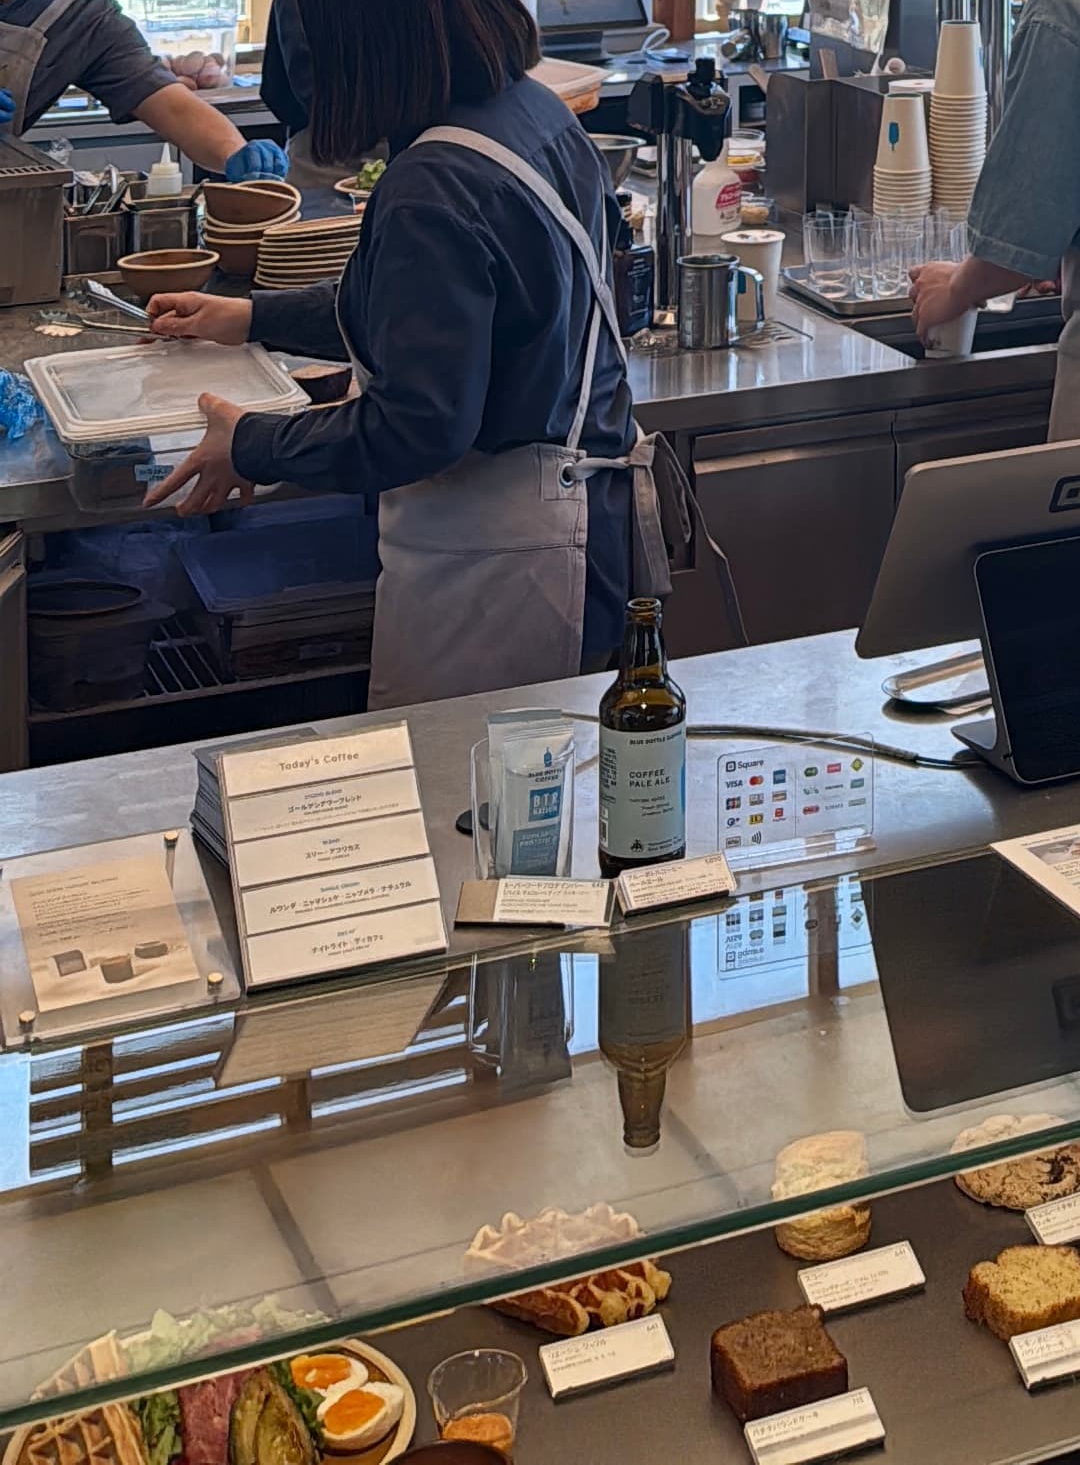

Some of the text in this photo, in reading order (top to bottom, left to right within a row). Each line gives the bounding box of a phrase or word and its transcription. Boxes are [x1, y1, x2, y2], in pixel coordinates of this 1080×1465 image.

[629, 736, 665, 746] BLUE BOTTLE
[279, 751, 360, 772] Today's Coffee
[737, 760, 765, 769] Square
[628, 768, 665, 779] COFFEE
[629, 776, 671, 788] PALE ALE
[725, 779, 744, 789] VISA
